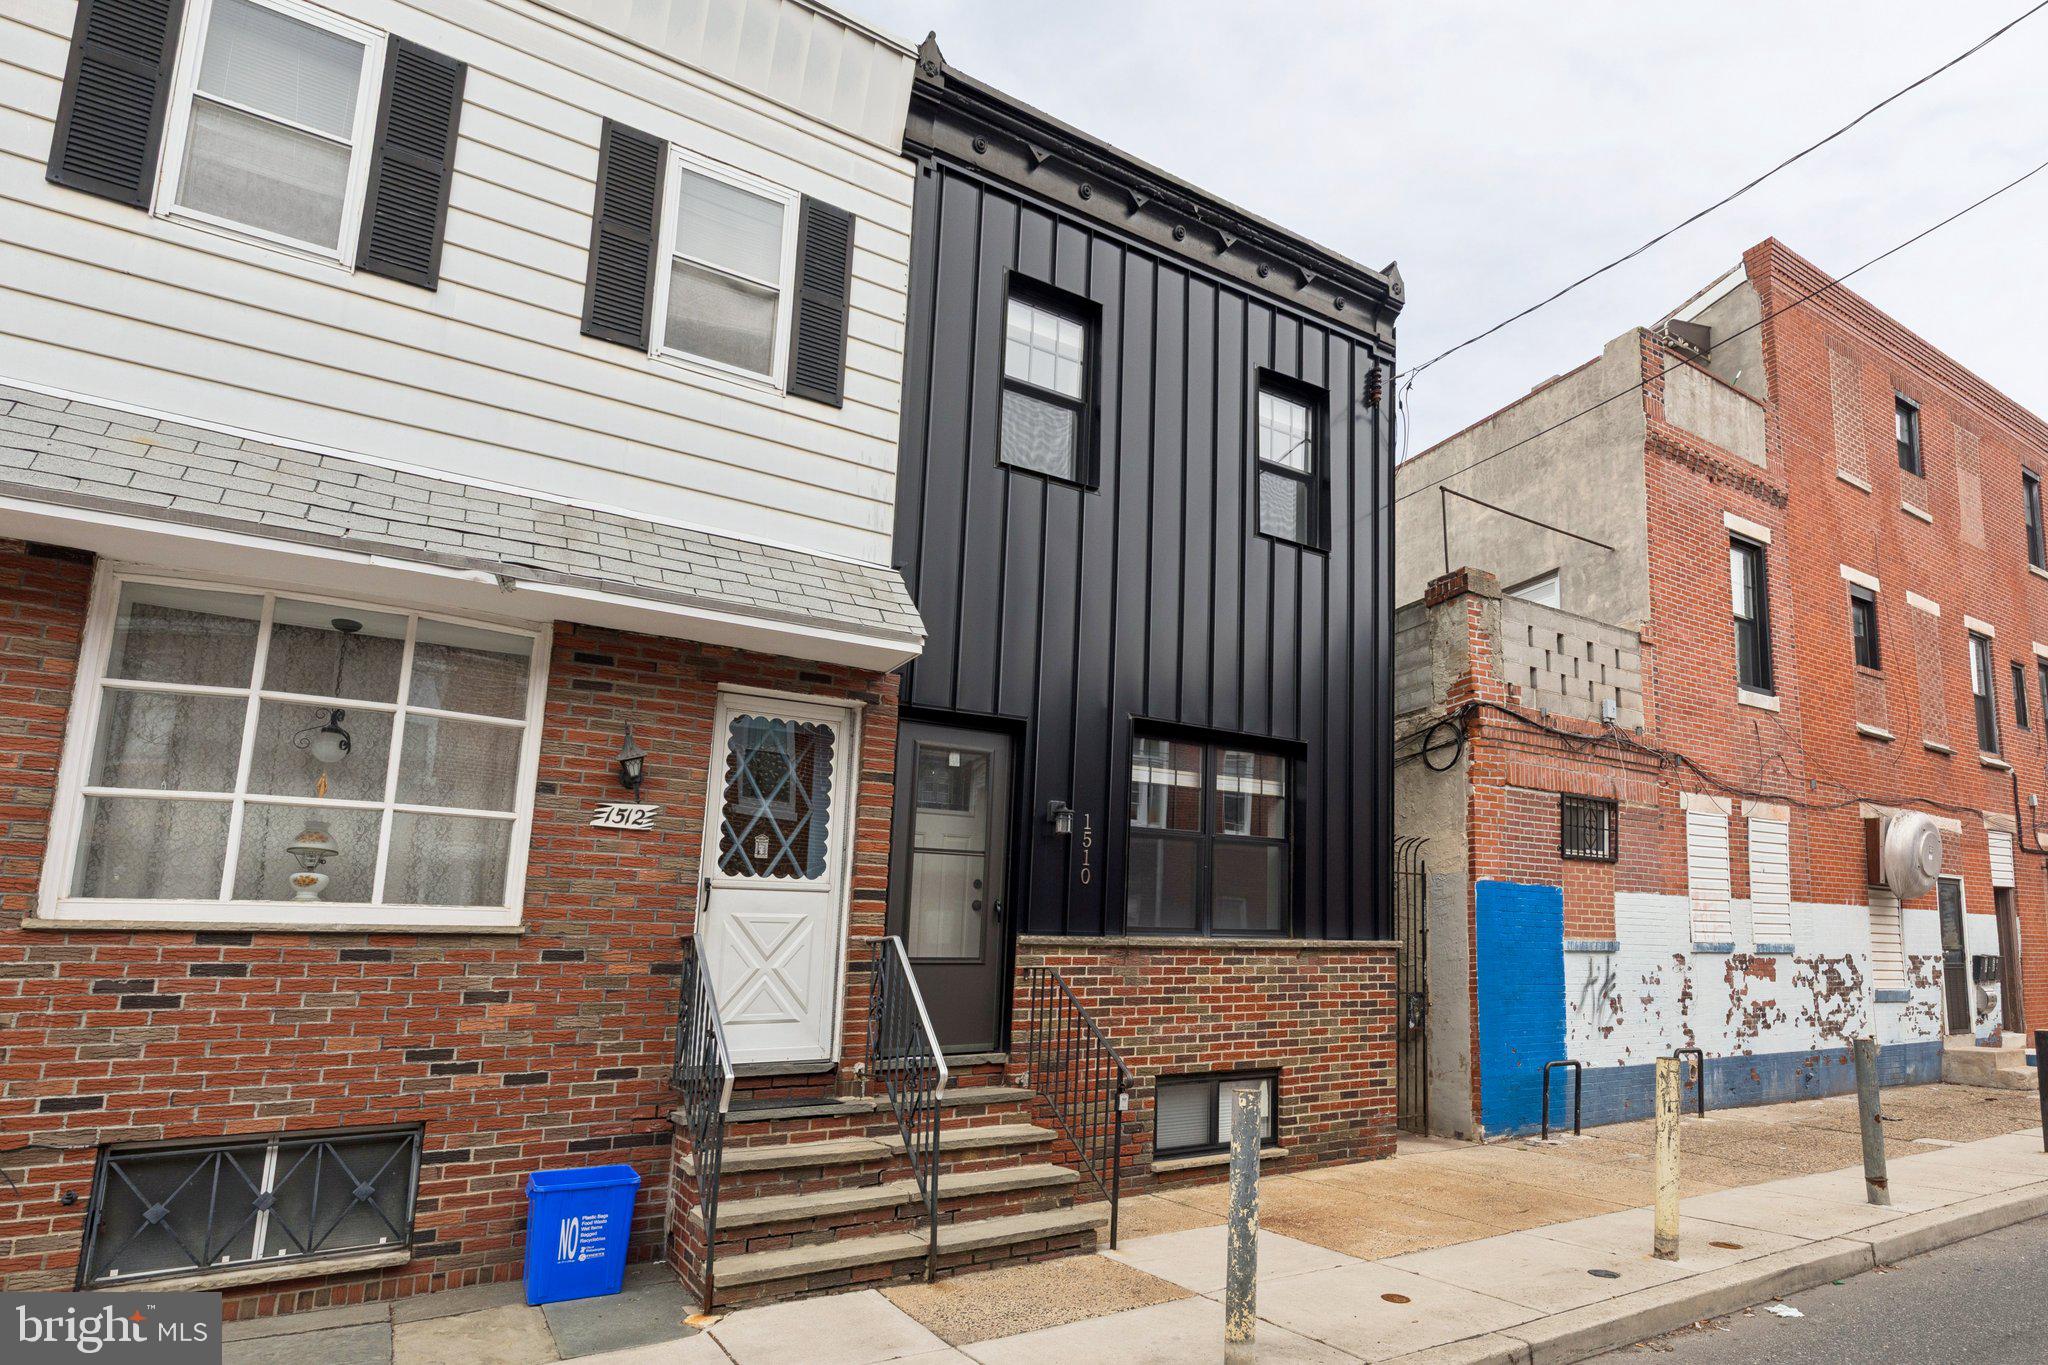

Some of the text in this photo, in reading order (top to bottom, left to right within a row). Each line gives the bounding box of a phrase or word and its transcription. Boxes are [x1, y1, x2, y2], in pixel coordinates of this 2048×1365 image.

[604, 807, 646, 826] 1512
[1081, 813, 1092, 885] 1510
[558, 1217, 579, 1260] NO
